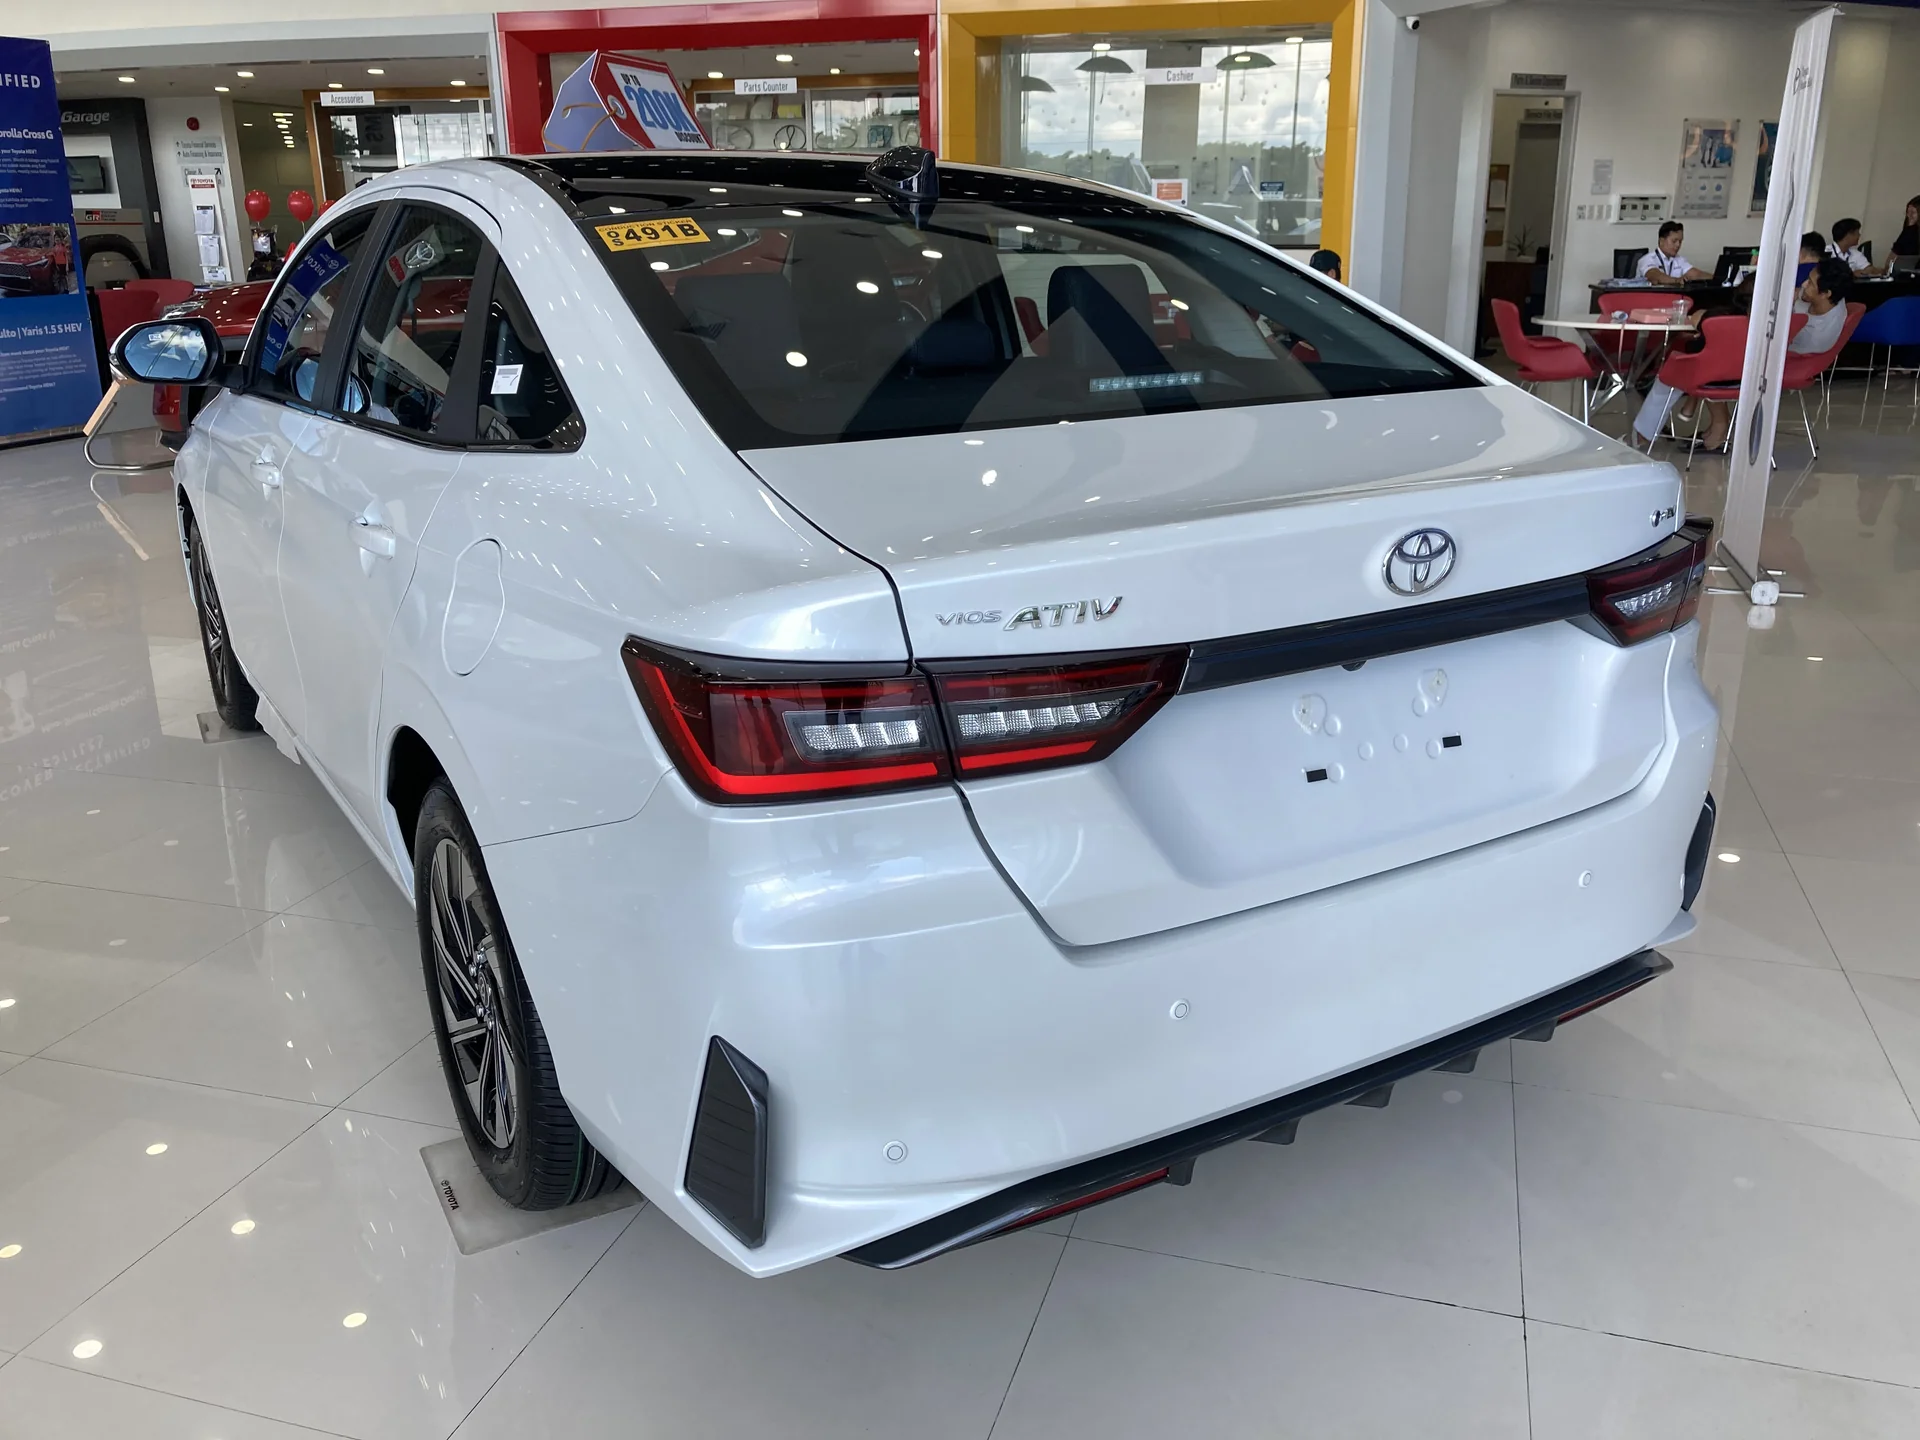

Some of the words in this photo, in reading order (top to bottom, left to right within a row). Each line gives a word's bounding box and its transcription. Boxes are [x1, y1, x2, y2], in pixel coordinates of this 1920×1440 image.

[620, 73, 632, 85] UP
[631, 75, 641, 87] TO
[1166, 70, 1194, 82] Cashier
[743, 81, 761, 92] Parts
[762, 81, 788, 92] Counter
[330, 94, 364, 104] Accessories
[624, 85, 698, 133] 200K
[60, 111, 110, 125] Garage
[22, 129, 46, 139] Cross
[45, 129, 54, 140] G
[599, 221, 656, 232] CONDUCTION
[656, 218, 692, 226] STICKER
[624, 223, 701, 242] 491B
[21, 325, 44, 337] Yaris
[43, 325, 57, 335] 1.5
[57, 324, 64, 334] S
[64, 322, 83, 333] HEV
[935, 609, 1003, 627] VIOS
[1003, 596, 1124, 632] ATIV
[443, 1185, 460, 1211] TOYOTA
